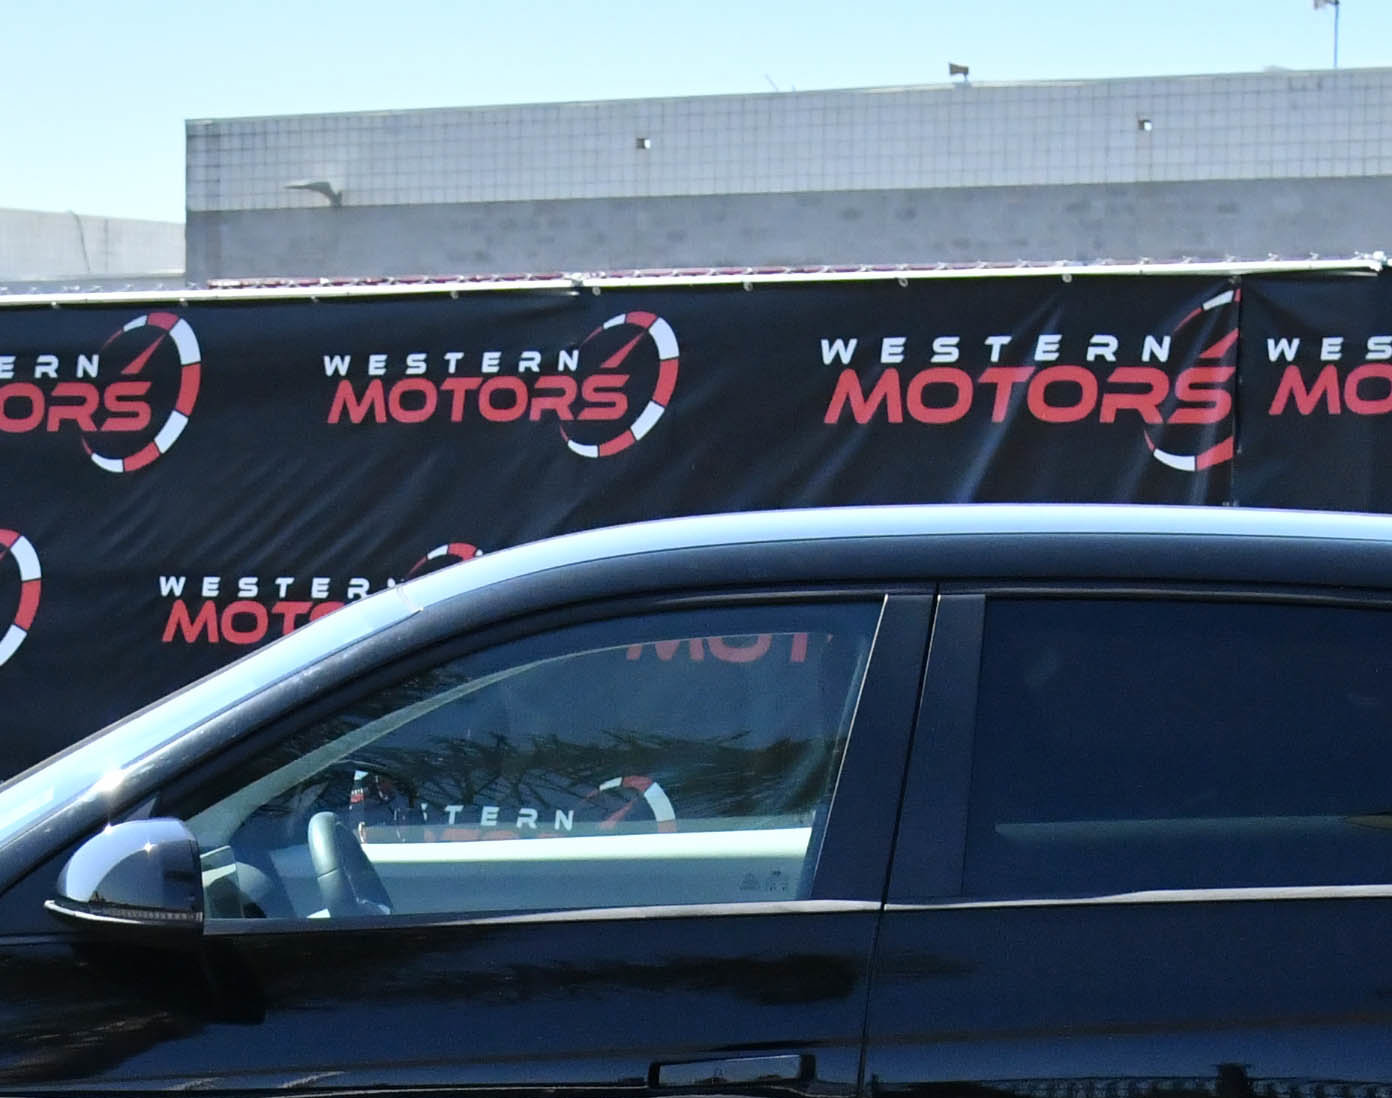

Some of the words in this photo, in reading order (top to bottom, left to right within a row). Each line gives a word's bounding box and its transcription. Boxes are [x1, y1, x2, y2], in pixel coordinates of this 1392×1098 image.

[323, 349, 580, 377] WESTERN
[820, 334, 1172, 366] WESTERN
[327, 373, 630, 425] MOTORS
[823, 364, 1236, 425] MOTORS
[159, 575, 405, 599] WESTER
[161, 599, 345, 646] MOT
[421, 804, 575, 832] TERN
